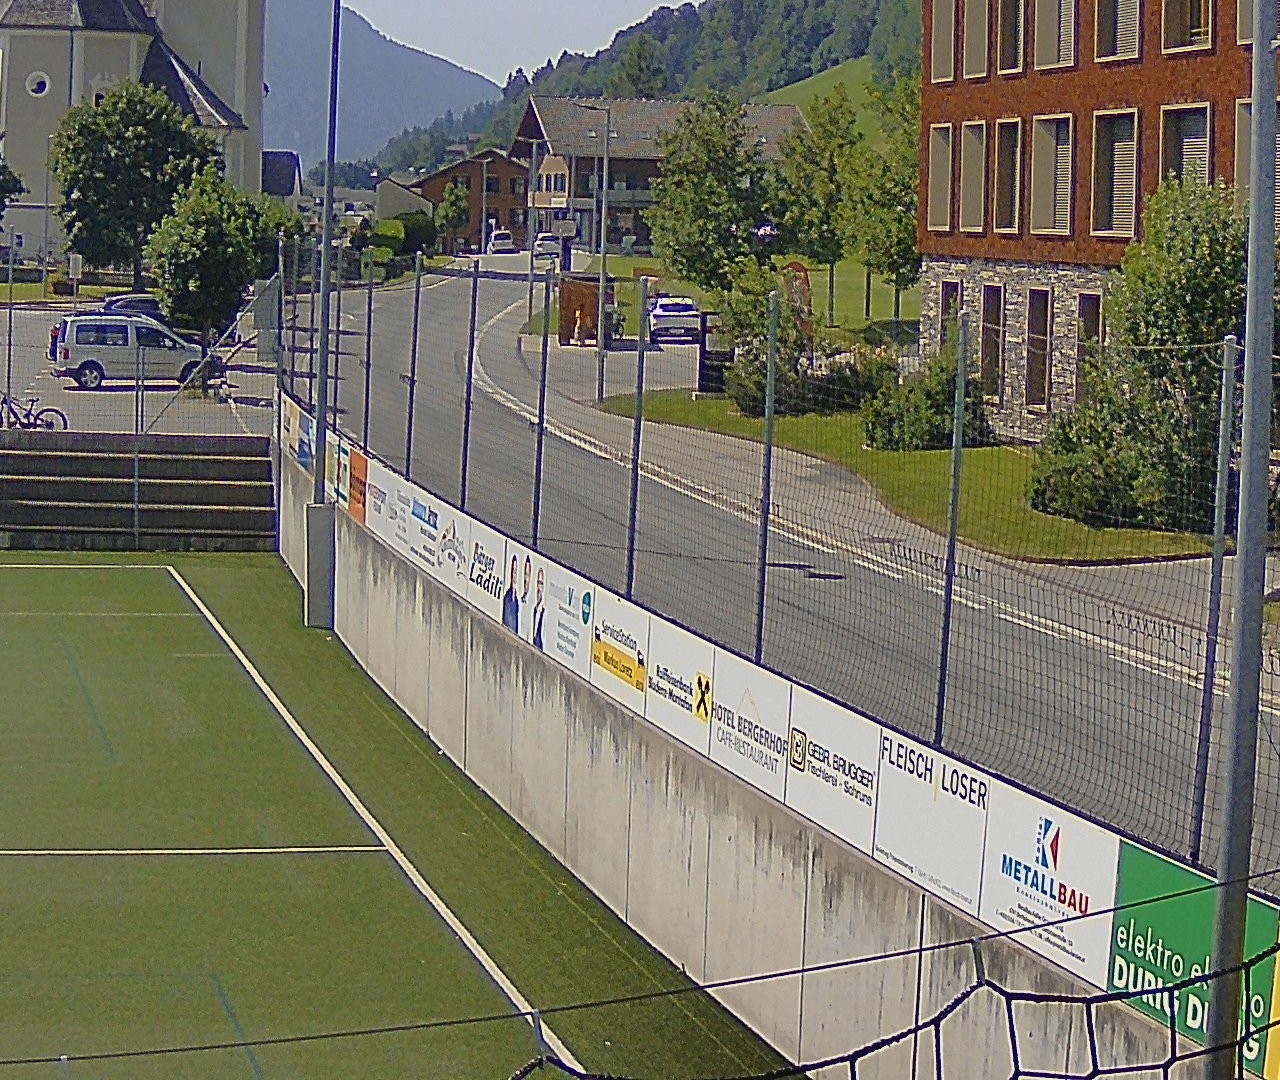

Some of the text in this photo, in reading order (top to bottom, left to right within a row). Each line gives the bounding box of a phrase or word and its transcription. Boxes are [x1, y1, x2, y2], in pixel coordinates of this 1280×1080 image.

[656, 664, 694, 697] Raiffeisenbank
[711, 701, 788, 757] HOTEL BERGERHOF
[807, 740, 874, 790] GEBR. BRUGGER
[807, 760, 838, 787] Tischlerei
[843, 781, 873, 807] Schruns
[881, 736, 988, 810] FLEISCH LOSER
[1001, 853, 1090, 915] METALLBAU
[1116, 918, 1184, 977] elektro
[1112, 954, 1180, 1017] DURIG
